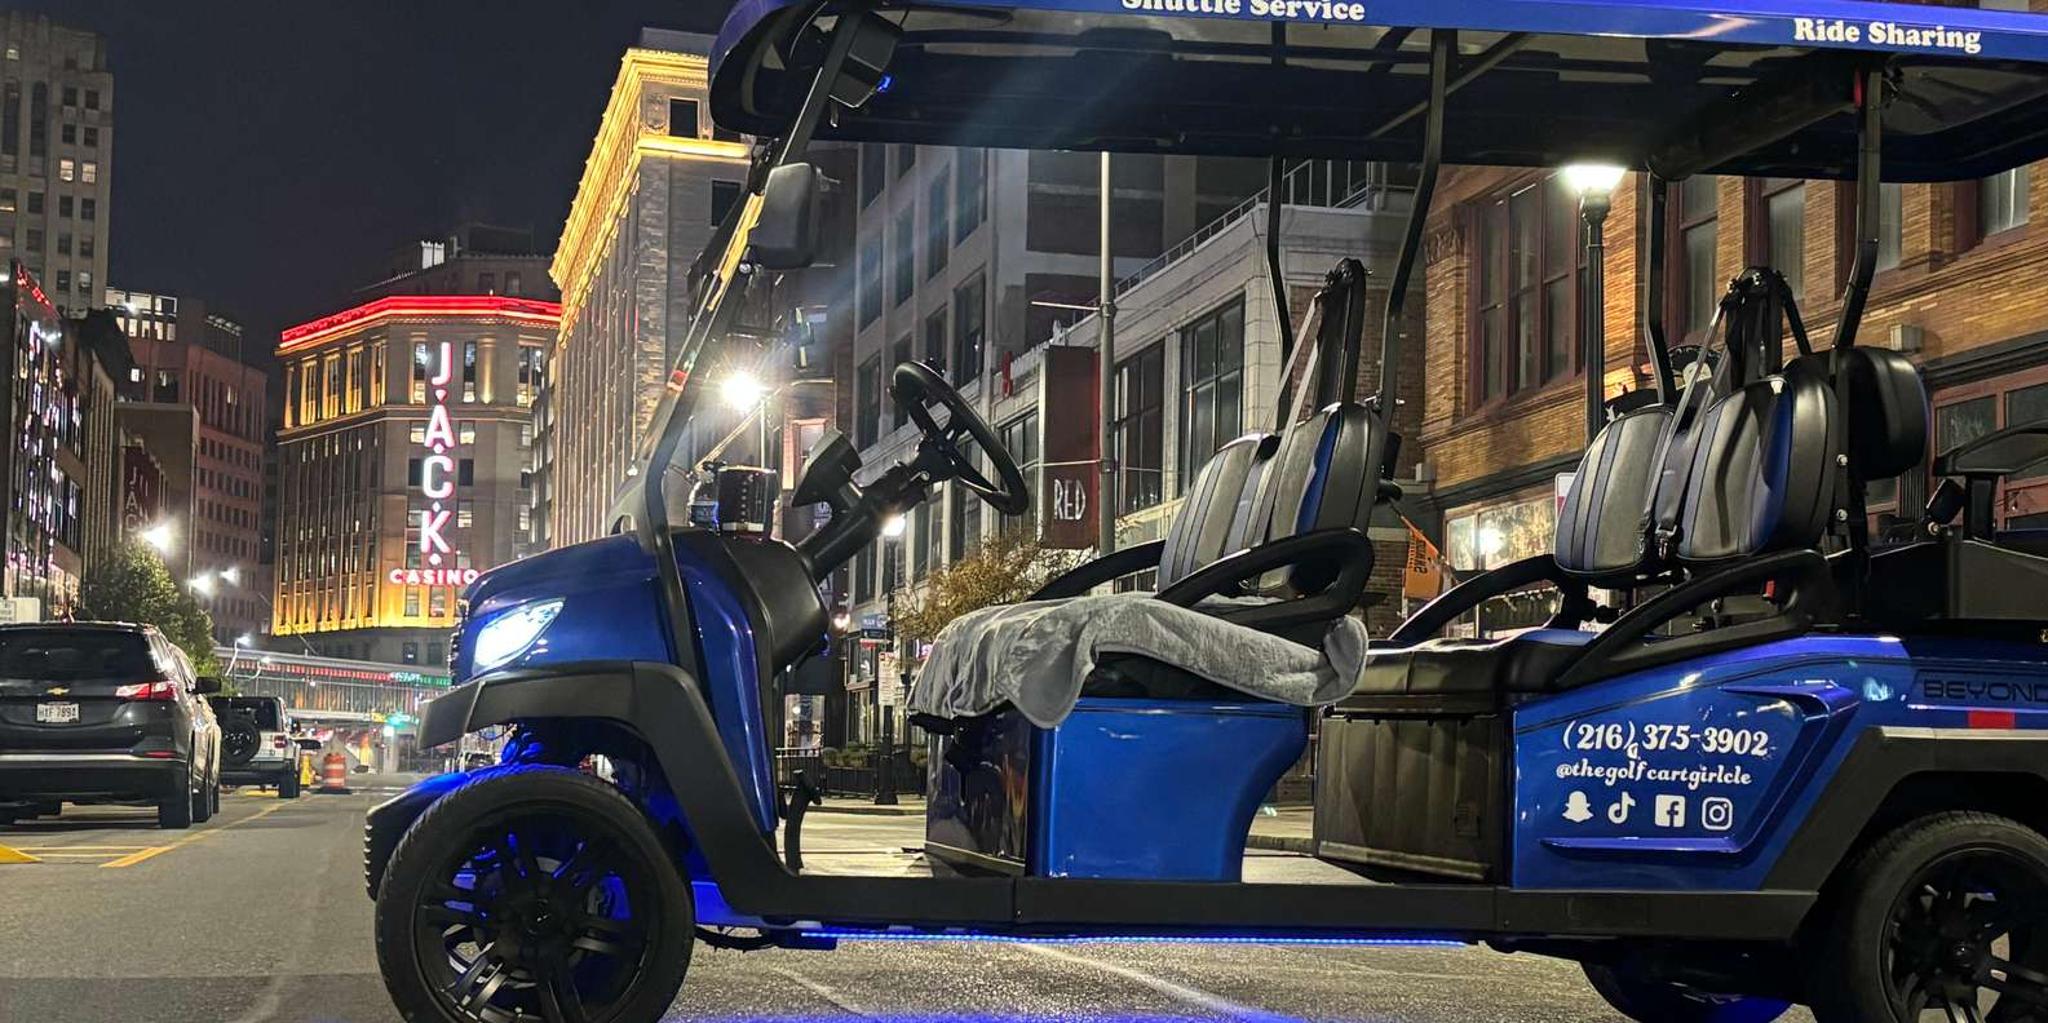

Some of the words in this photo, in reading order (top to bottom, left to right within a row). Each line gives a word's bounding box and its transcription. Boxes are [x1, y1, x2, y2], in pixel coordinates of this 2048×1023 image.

[1250, 0, 1366, 20] Service
[1793, 18, 1861, 42] Ride
[1868, 22, 1982, 54] Sharing
[420, 341, 456, 554] JACK
[1054, 478, 1086, 520] RED
[389, 568, 479, 586] CASINO
[1563, 720, 1636, 750] (216)
[1642, 724, 1769, 757] 375-3902
